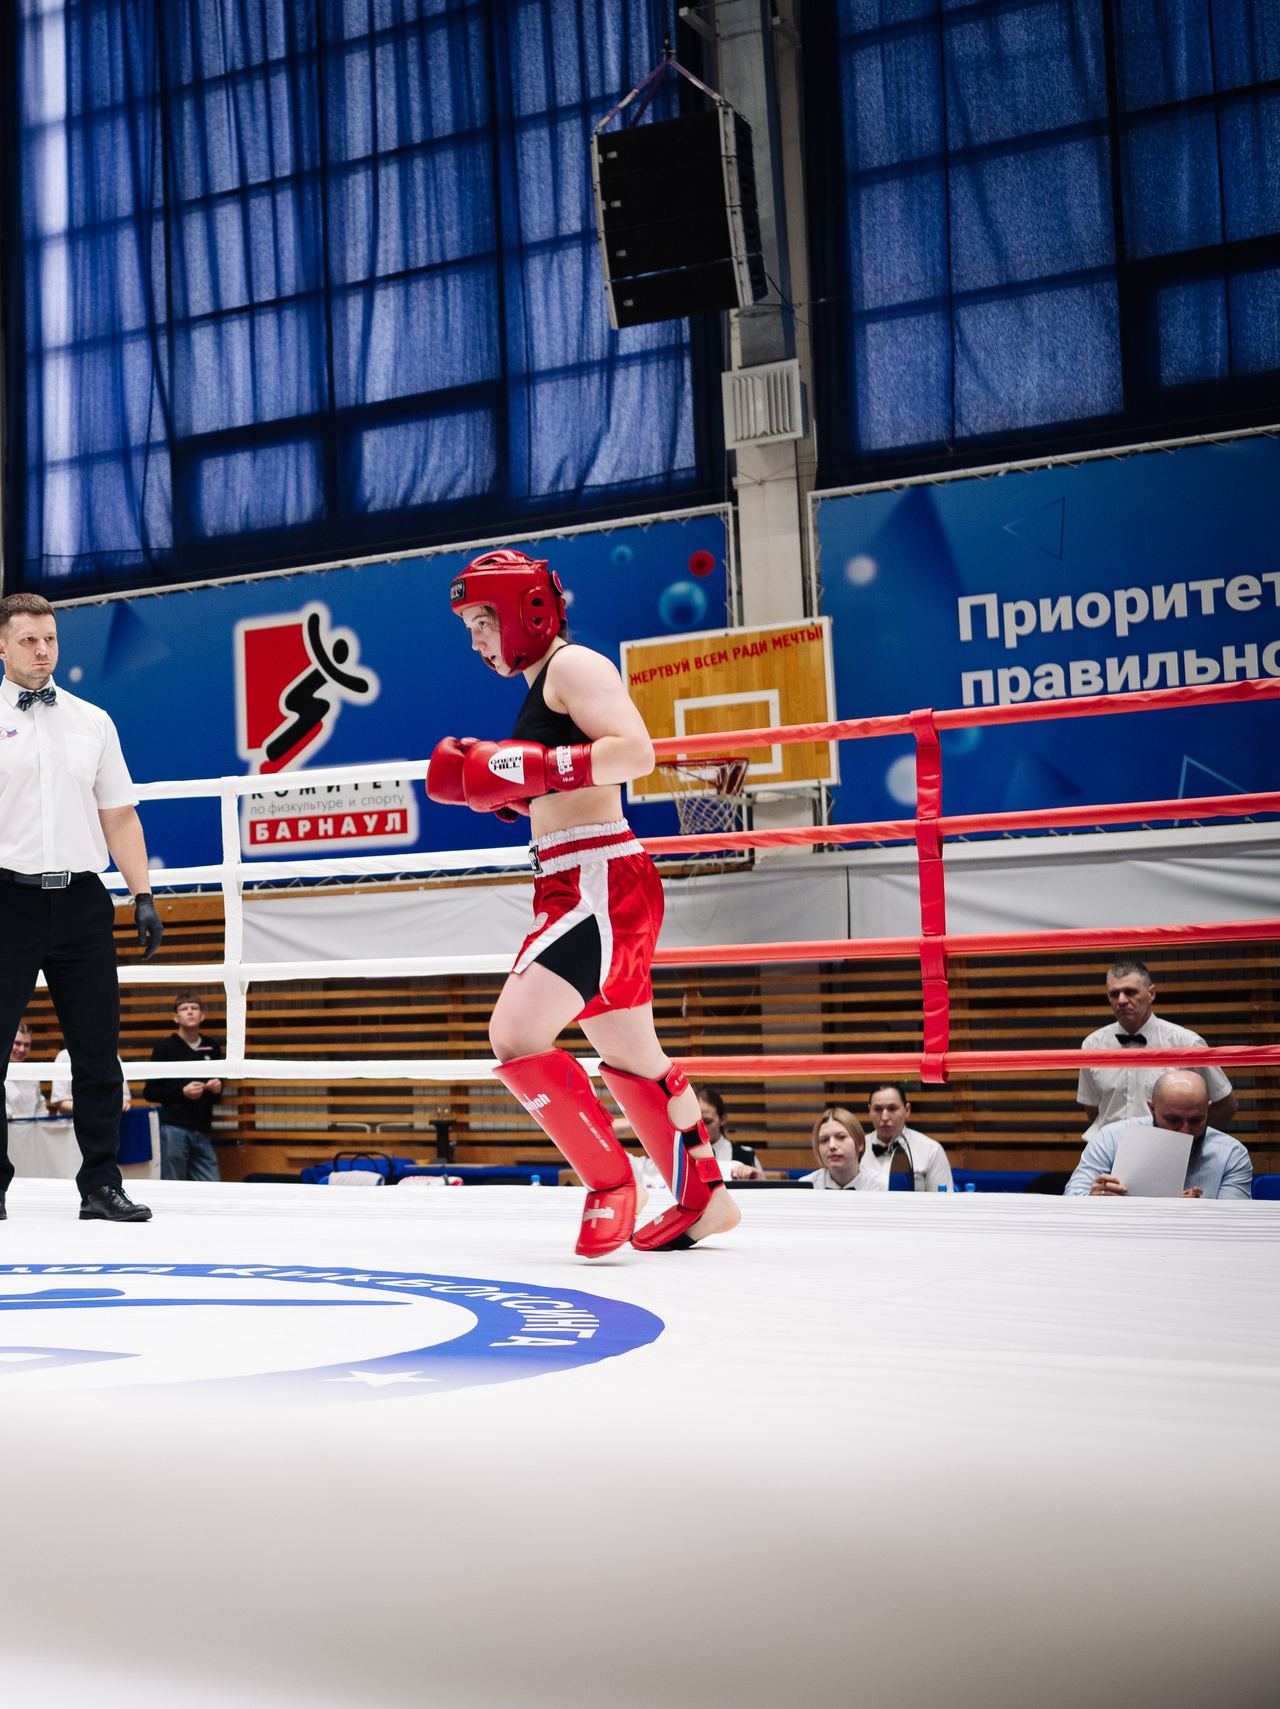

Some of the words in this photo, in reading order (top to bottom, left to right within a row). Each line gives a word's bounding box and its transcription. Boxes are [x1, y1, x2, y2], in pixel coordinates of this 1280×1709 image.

[629, 658, 690, 686] ЖЕРТВУЙ
[694, 649, 729, 669] ВСЕМ
[732, 640, 768, 660] РАДИ
[772, 626, 823, 650] МЕЧТЫ!
[490, 755, 522, 765] GREEN
[493, 761, 520, 771] HILL
[556, 745, 565, 775] GREE
[250, 804, 265, 815] по
[268, 798, 343, 816] физкультуре
[349, 798, 356, 807] и
[361, 794, 404, 809] спорту
[255, 812, 401, 842] БАРНАУЛ
[207, 1266, 600, 1348] КИКБОКСИНГА
